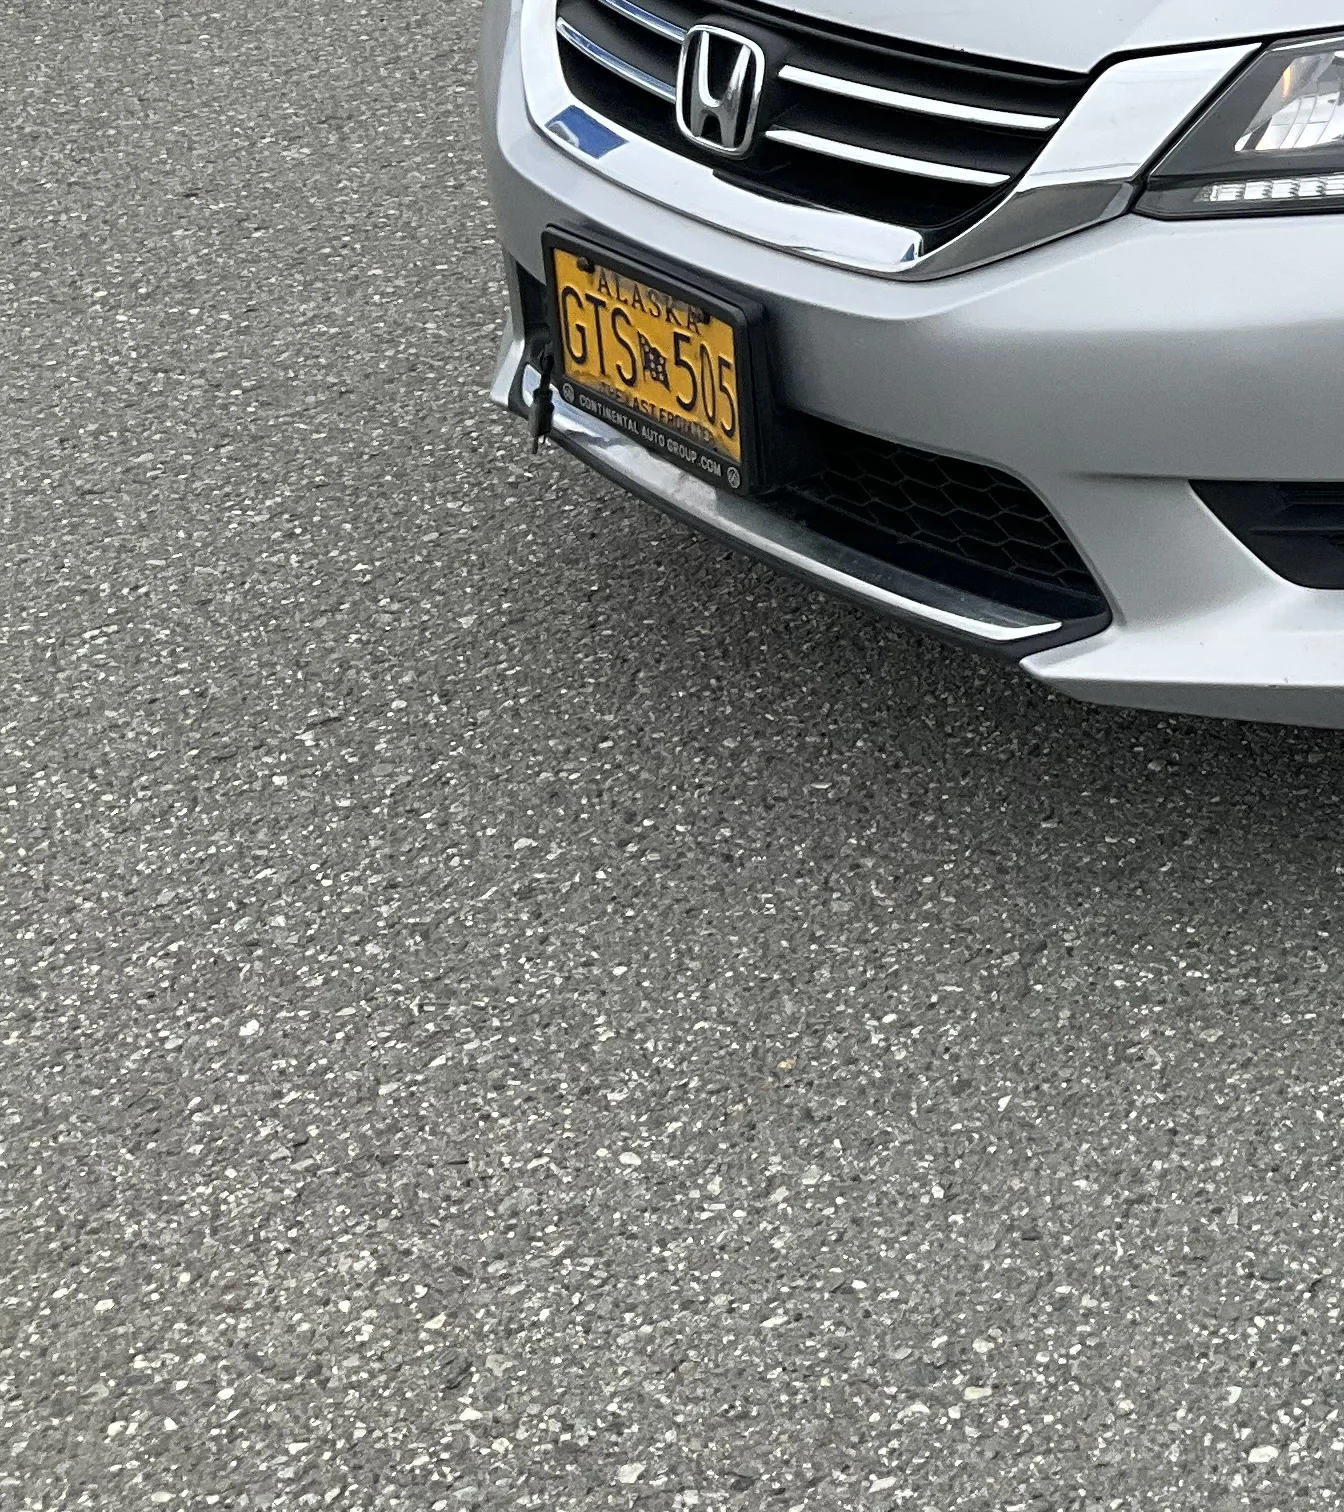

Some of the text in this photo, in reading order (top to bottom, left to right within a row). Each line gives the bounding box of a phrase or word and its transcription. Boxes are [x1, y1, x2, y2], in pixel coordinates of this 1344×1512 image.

[596, 270, 701, 335] ALASKA
[561, 285, 737, 439] GTS 505
[579, 394, 640, 435] CONTINENTAL
[641, 426, 665, 447] AUTO
[666, 438, 697, 464] GROUP
